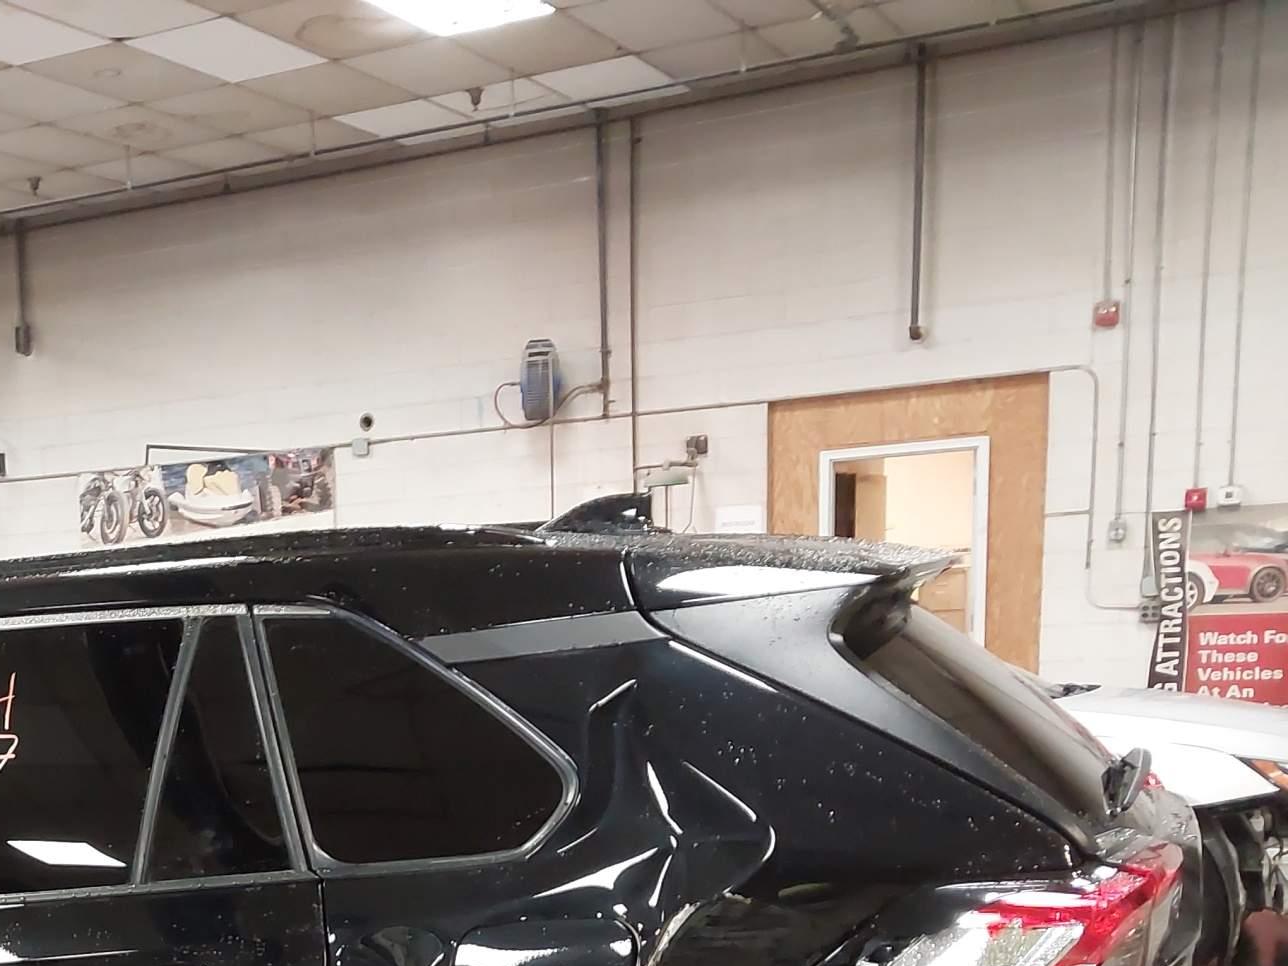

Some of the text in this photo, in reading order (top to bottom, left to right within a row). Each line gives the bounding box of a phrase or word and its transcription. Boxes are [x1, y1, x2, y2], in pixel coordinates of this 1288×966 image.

[1154, 516, 1184, 677] ATTRACTIONS
[1198, 629, 1288, 646] Watch Fo
[1197, 650, 1259, 664] These
[1197, 666, 1284, 681] Vehicles
[1225, 684, 1255, 698] An
